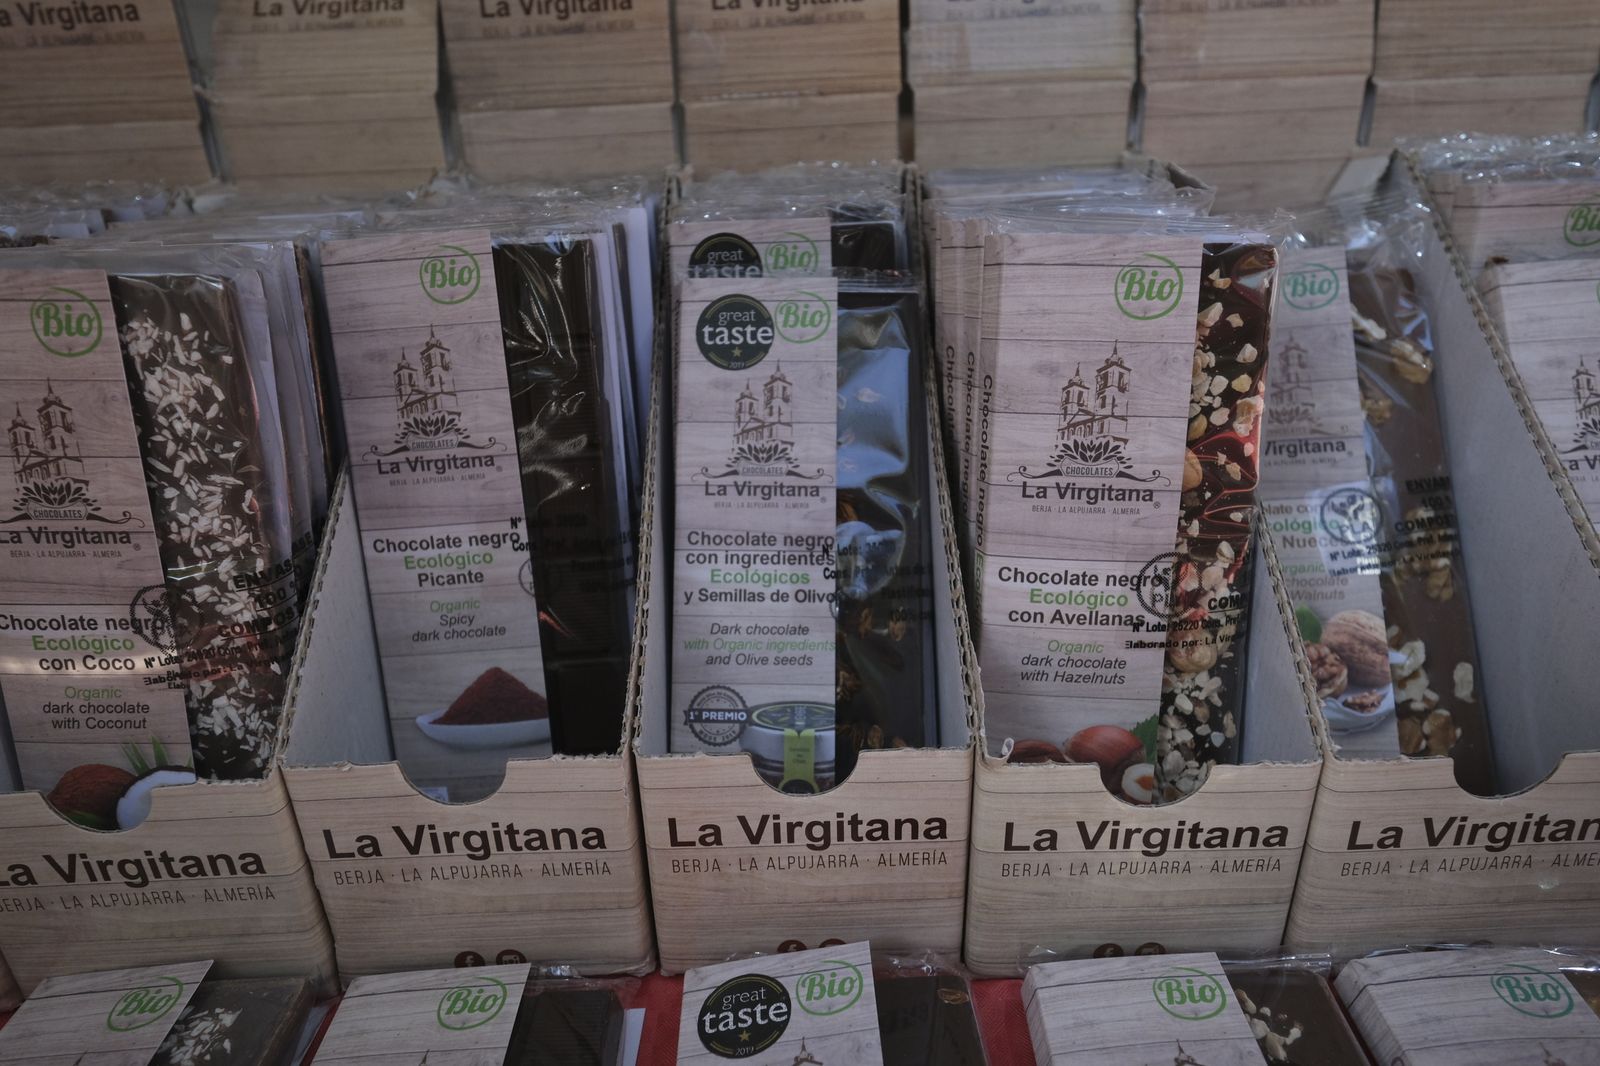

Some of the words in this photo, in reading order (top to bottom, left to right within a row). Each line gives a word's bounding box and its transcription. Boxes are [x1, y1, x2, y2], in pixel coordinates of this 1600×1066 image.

[16, 1, 140, 31] Virgitana
[1571, 207, 1600, 232] Bi
[707, 249, 743, 265] great
[769, 243, 814, 270] Bio
[424, 259, 477, 289] Bio
[1121, 267, 1178, 301] Bio
[1286, 274, 1332, 297] Bio
[35, 303, 96, 337] Bio
[718, 309, 756, 325] great
[779, 302, 825, 328] Bio
[702, 323, 774, 345] taste
[964, 351, 976, 453] Chocolate
[979, 374, 993, 482] Chocolate
[412, 439, 453, 449] CHOCOLATES
[377, 458, 401, 475] La
[405, 453, 495, 475] Virgitana
[742, 466, 783, 475] CHOCOLATES
[1065, 466, 1113, 476] CHOCOLATES
[705, 481, 727, 496] La
[733, 480, 820, 500] Virgitana
[1021, 481, 1048, 499] La
[1055, 482, 1153, 505] Virgitana
[33, 509, 82, 519] CHOCOLATES
[1032, 504, 1052, 512] BERJA
[1057, 505, 1067, 513] LA
[1069, 506, 1106, 514] ALPUJARRA
[27, 526, 132, 549] Virgitana
[373, 532, 463, 554] Chocolate
[468, 531, 520, 550] negro
[687, 531, 777, 547] Chocolate
[783, 535, 835, 551] negro
[404, 551, 494, 572] Ecológico
[685, 552, 718, 565] con
[724, 550, 836, 569] ingredientes
[417, 569, 485, 587] Picante
[710, 568, 811, 588] Ecológicos
[998, 566, 1098, 588] Chocolate
[1105, 571, 1163, 592] negro
[684, 591, 694, 605] y
[698, 588, 765, 603] Semillas
[770, 588, 789, 603] de
[1029, 588, 1128, 610] Ecológico
[1290, 588, 1346, 601] Walnuts
[430, 599, 481, 614] Organic
[0, 614, 98, 632] Chocolate
[104, 616, 166, 637] negro
[439, 614, 475, 628] Spicy
[1008, 609, 1045, 623] con
[1050, 609, 1146, 627] Avellanas
[412, 629, 440, 642] dark
[444, 625, 507, 641] chocolate
[710, 623, 741, 635] Dark
[745, 623, 810, 636] chocolate
[32, 634, 135, 655] Ecológico
[684, 638, 709, 650] with
[713, 638, 763, 653] Organic
[766, 638, 837, 653] ingredients
[1047, 640, 1104, 656] Organic
[1182, 639, 1203, 649] por:
[39, 656, 76, 671] con
[82, 655, 136, 671] Coco
[706, 653, 731, 666] and
[735, 653, 769, 666] Olive
[773, 654, 813, 666] seeds
[1021, 654, 1052, 667] dark
[1057, 656, 1127, 670] chocolate
[1020, 669, 1049, 682] with
[1053, 671, 1127, 685] Hazelnuts
[64, 685, 123, 701] Organic
[42, 701, 74, 714] dark
[79, 701, 150, 715] chocolate
[702, 711, 747, 721] PREMIO
[52, 715, 80, 729] with
[85, 715, 147, 729] Coconut
[322, 829, 383, 859] La
[391, 822, 608, 861] Virgitana
[667, 817, 723, 847] La
[737, 812, 948, 851] Virgitana
[1003, 822, 1058, 851] La
[1076, 820, 1290, 857] Virgitana
[1346, 820, 1404, 851] La
[1423, 813, 1600, 852] Virgitan
[42, 850, 267, 888] Virgitana
[672, 858, 721, 873] BERJA
[739, 857, 758, 871] LA
[766, 854, 860, 871] ALPUJARRA
[878, 849, 948, 867] ALMERÍA
[1001, 863, 1051, 877] BERJA
[1069, 862, 1089, 876] LA
[1097, 860, 1192, 875] ALPUJARRA
[1210, 858, 1281, 874] ALMERÍA
[1340, 861, 1391, 877] BERJA
[1409, 859, 1429, 874] LA
[1437, 854, 1533, 872] ALPUJARRA
[334, 869, 385, 886] BERJA
[401, 866, 423, 882] LA
[430, 863, 523, 881] ALPUJARRA
[541, 860, 612, 878] ALMERÍA
[60, 893, 84, 909] LA
[90, 889, 186, 908] ALPUJARRA
[203, 886, 275, 902] ALMERÍA
[801, 967, 857, 1001] Bio
[1158, 978, 1218, 1005] Bio
[1496, 975, 1561, 1003] Bio
[117, 987, 175, 1017] Bio
[445, 988, 502, 1015] Bio
[722, 986, 766, 1011] great
[702, 1001, 789, 1035] taste
[735, 1046, 754, 1056] 2019
